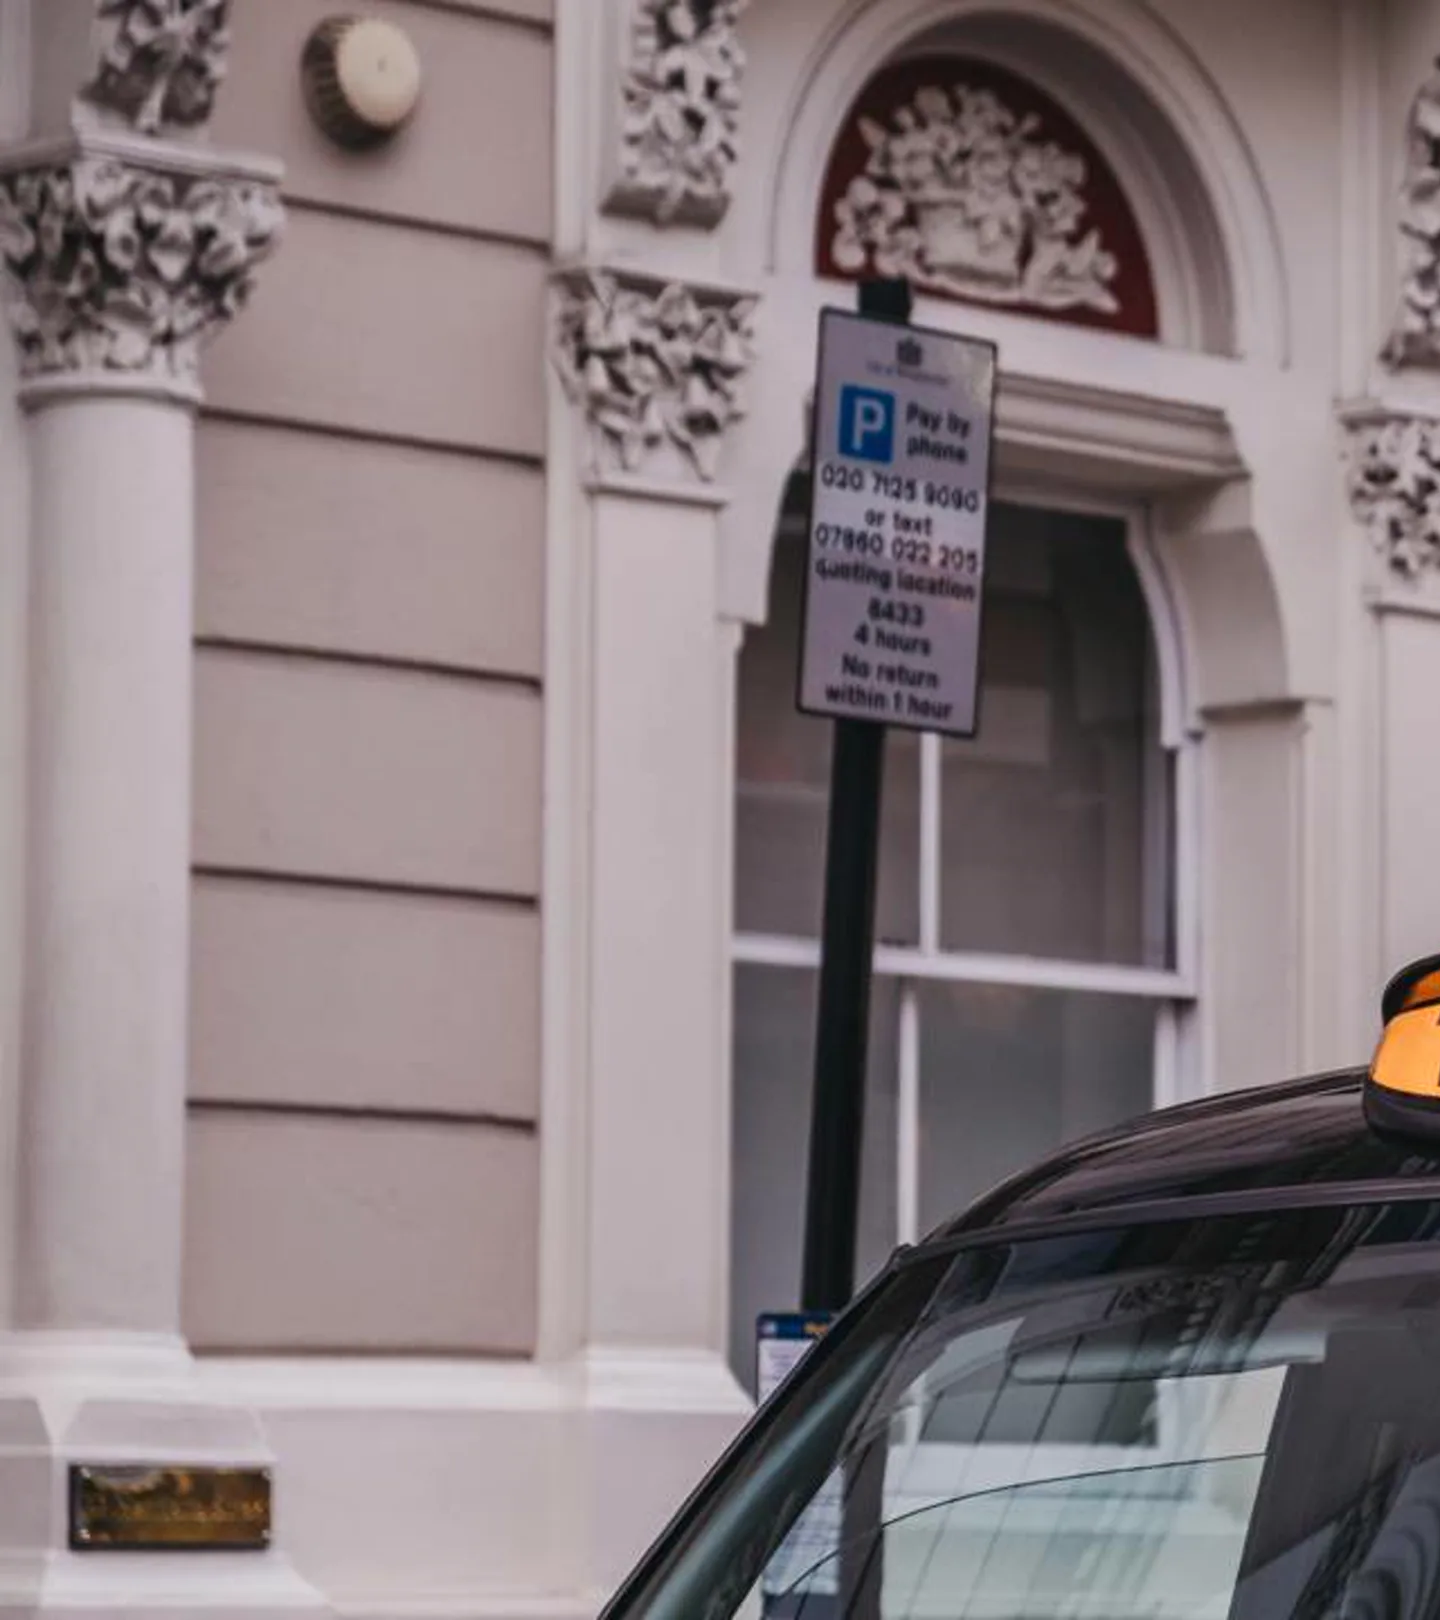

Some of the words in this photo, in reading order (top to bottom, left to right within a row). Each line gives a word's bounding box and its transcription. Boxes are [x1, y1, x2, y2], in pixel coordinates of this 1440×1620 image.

[852, 397, 885, 450] P
[905, 401, 942, 434] Pay
[947, 410, 971, 440] by
[906, 435, 968, 465] phone
[821, 463, 864, 491] 020
[872, 470, 917, 501] 7125
[924, 481, 979, 513] 9090
[864, 508, 885, 527] or
[892, 511, 933, 537] text
[815, 522, 883, 556] 07860
[891, 536, 932, 566] 022
[938, 544, 978, 575] 205
[897, 566, 976, 600] location
[868, 597, 925, 627] 8433
[853, 622, 869, 645] 4
[875, 626, 932, 656] hours
[841, 652, 869, 679] No
[876, 662, 940, 689] return
[825, 684, 887, 710] within
[893, 691, 901, 712] 1
[907, 694, 953, 719] hour
